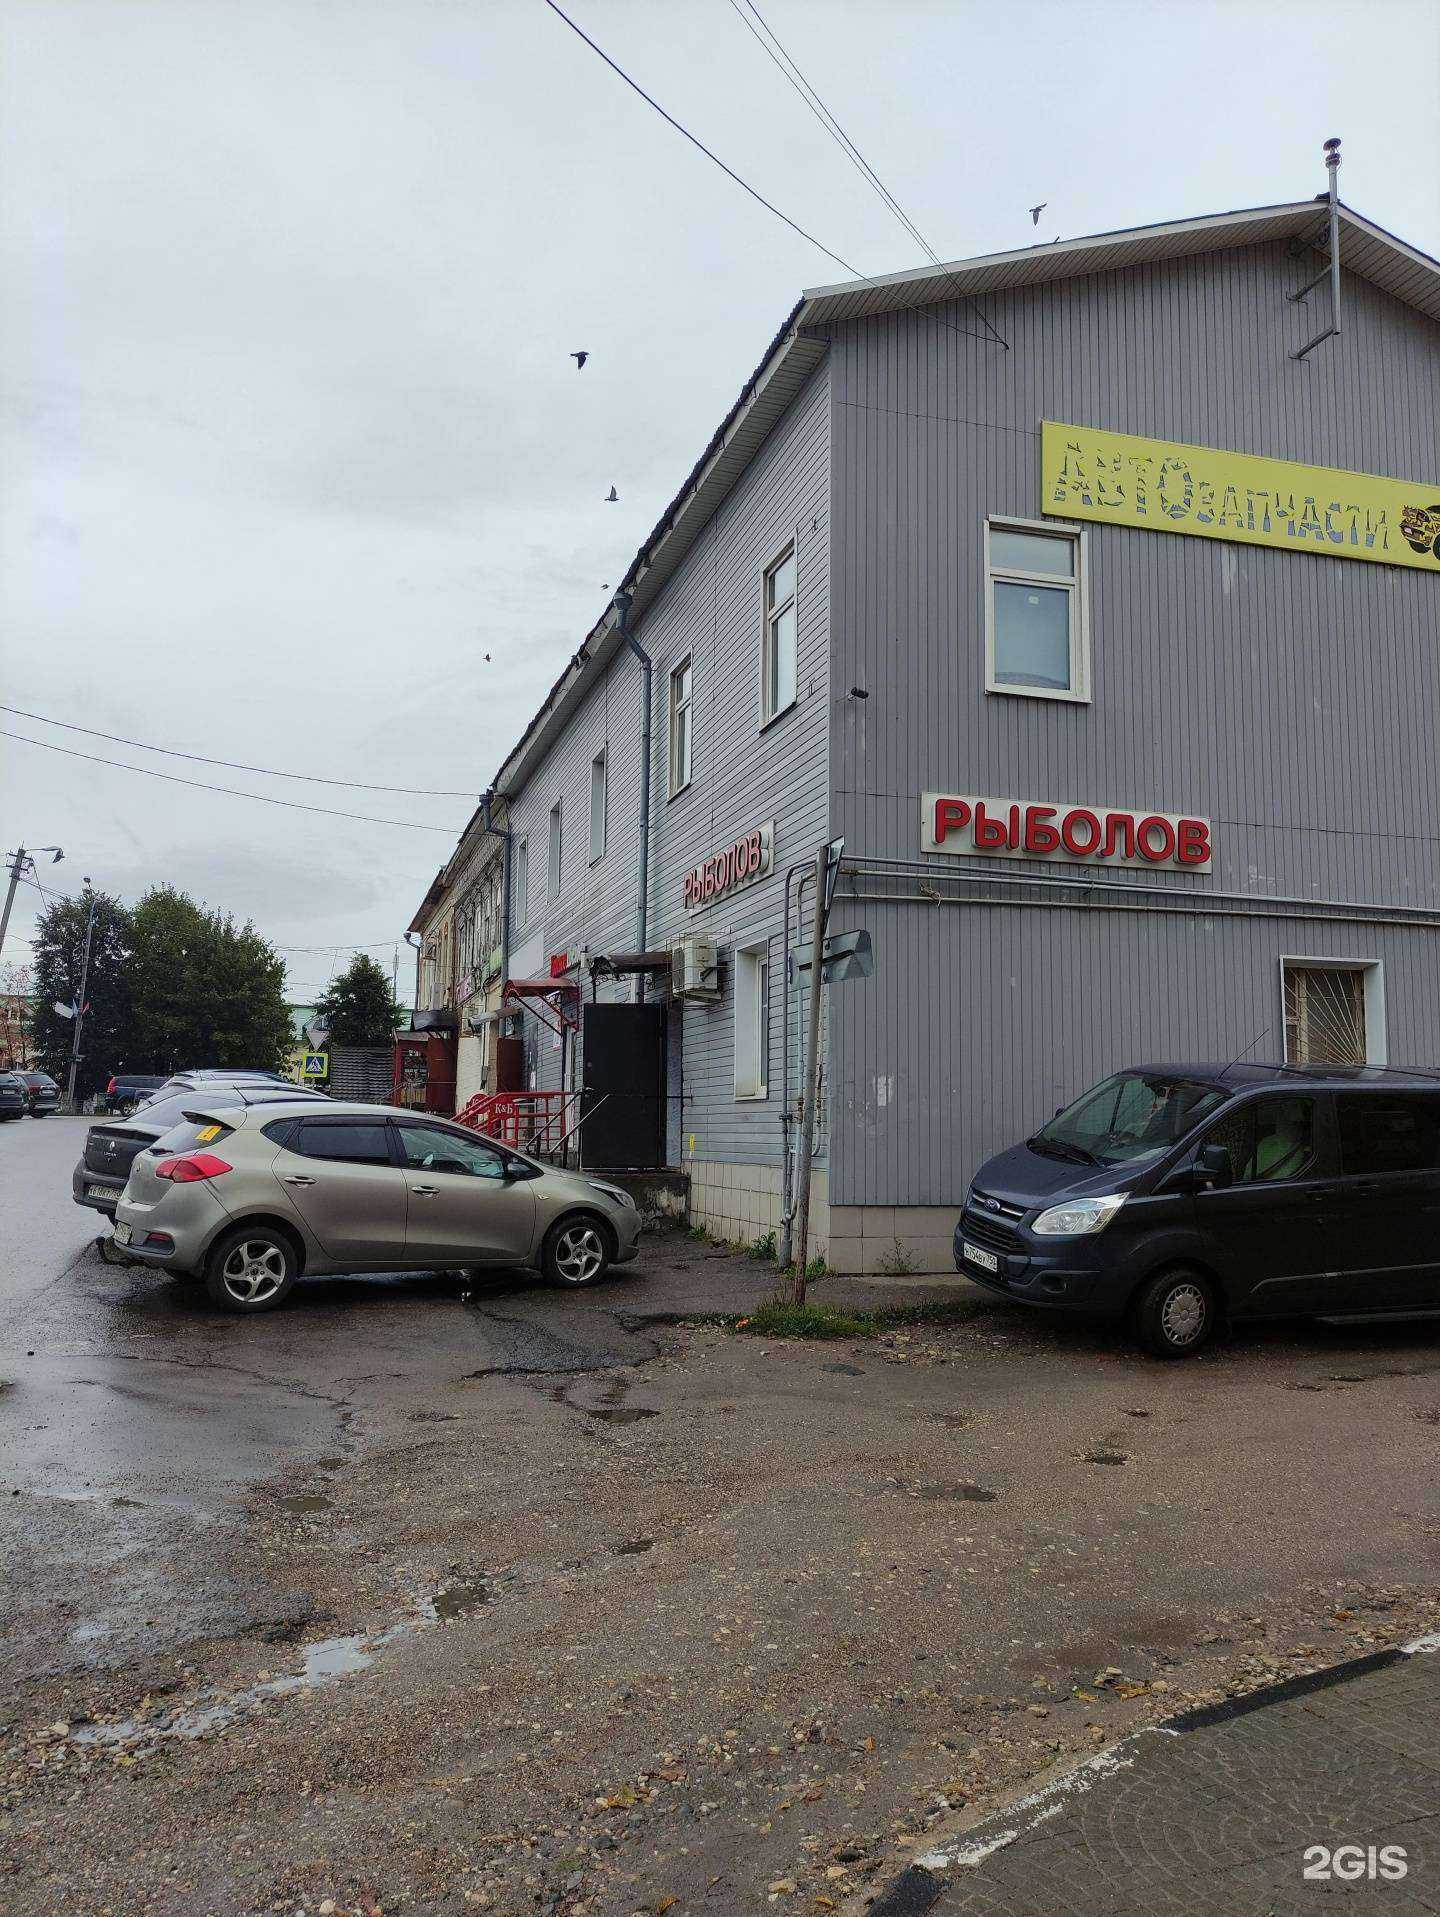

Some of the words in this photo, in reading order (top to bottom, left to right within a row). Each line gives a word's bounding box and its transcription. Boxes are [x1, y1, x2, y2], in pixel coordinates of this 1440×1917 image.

[1052, 440, 1390, 550] АВТОЗАПЧАСТИ
[683, 830, 762, 909] РЫБОЛОВ
[933, 797, 1212, 865] РЫБОЛОВ
